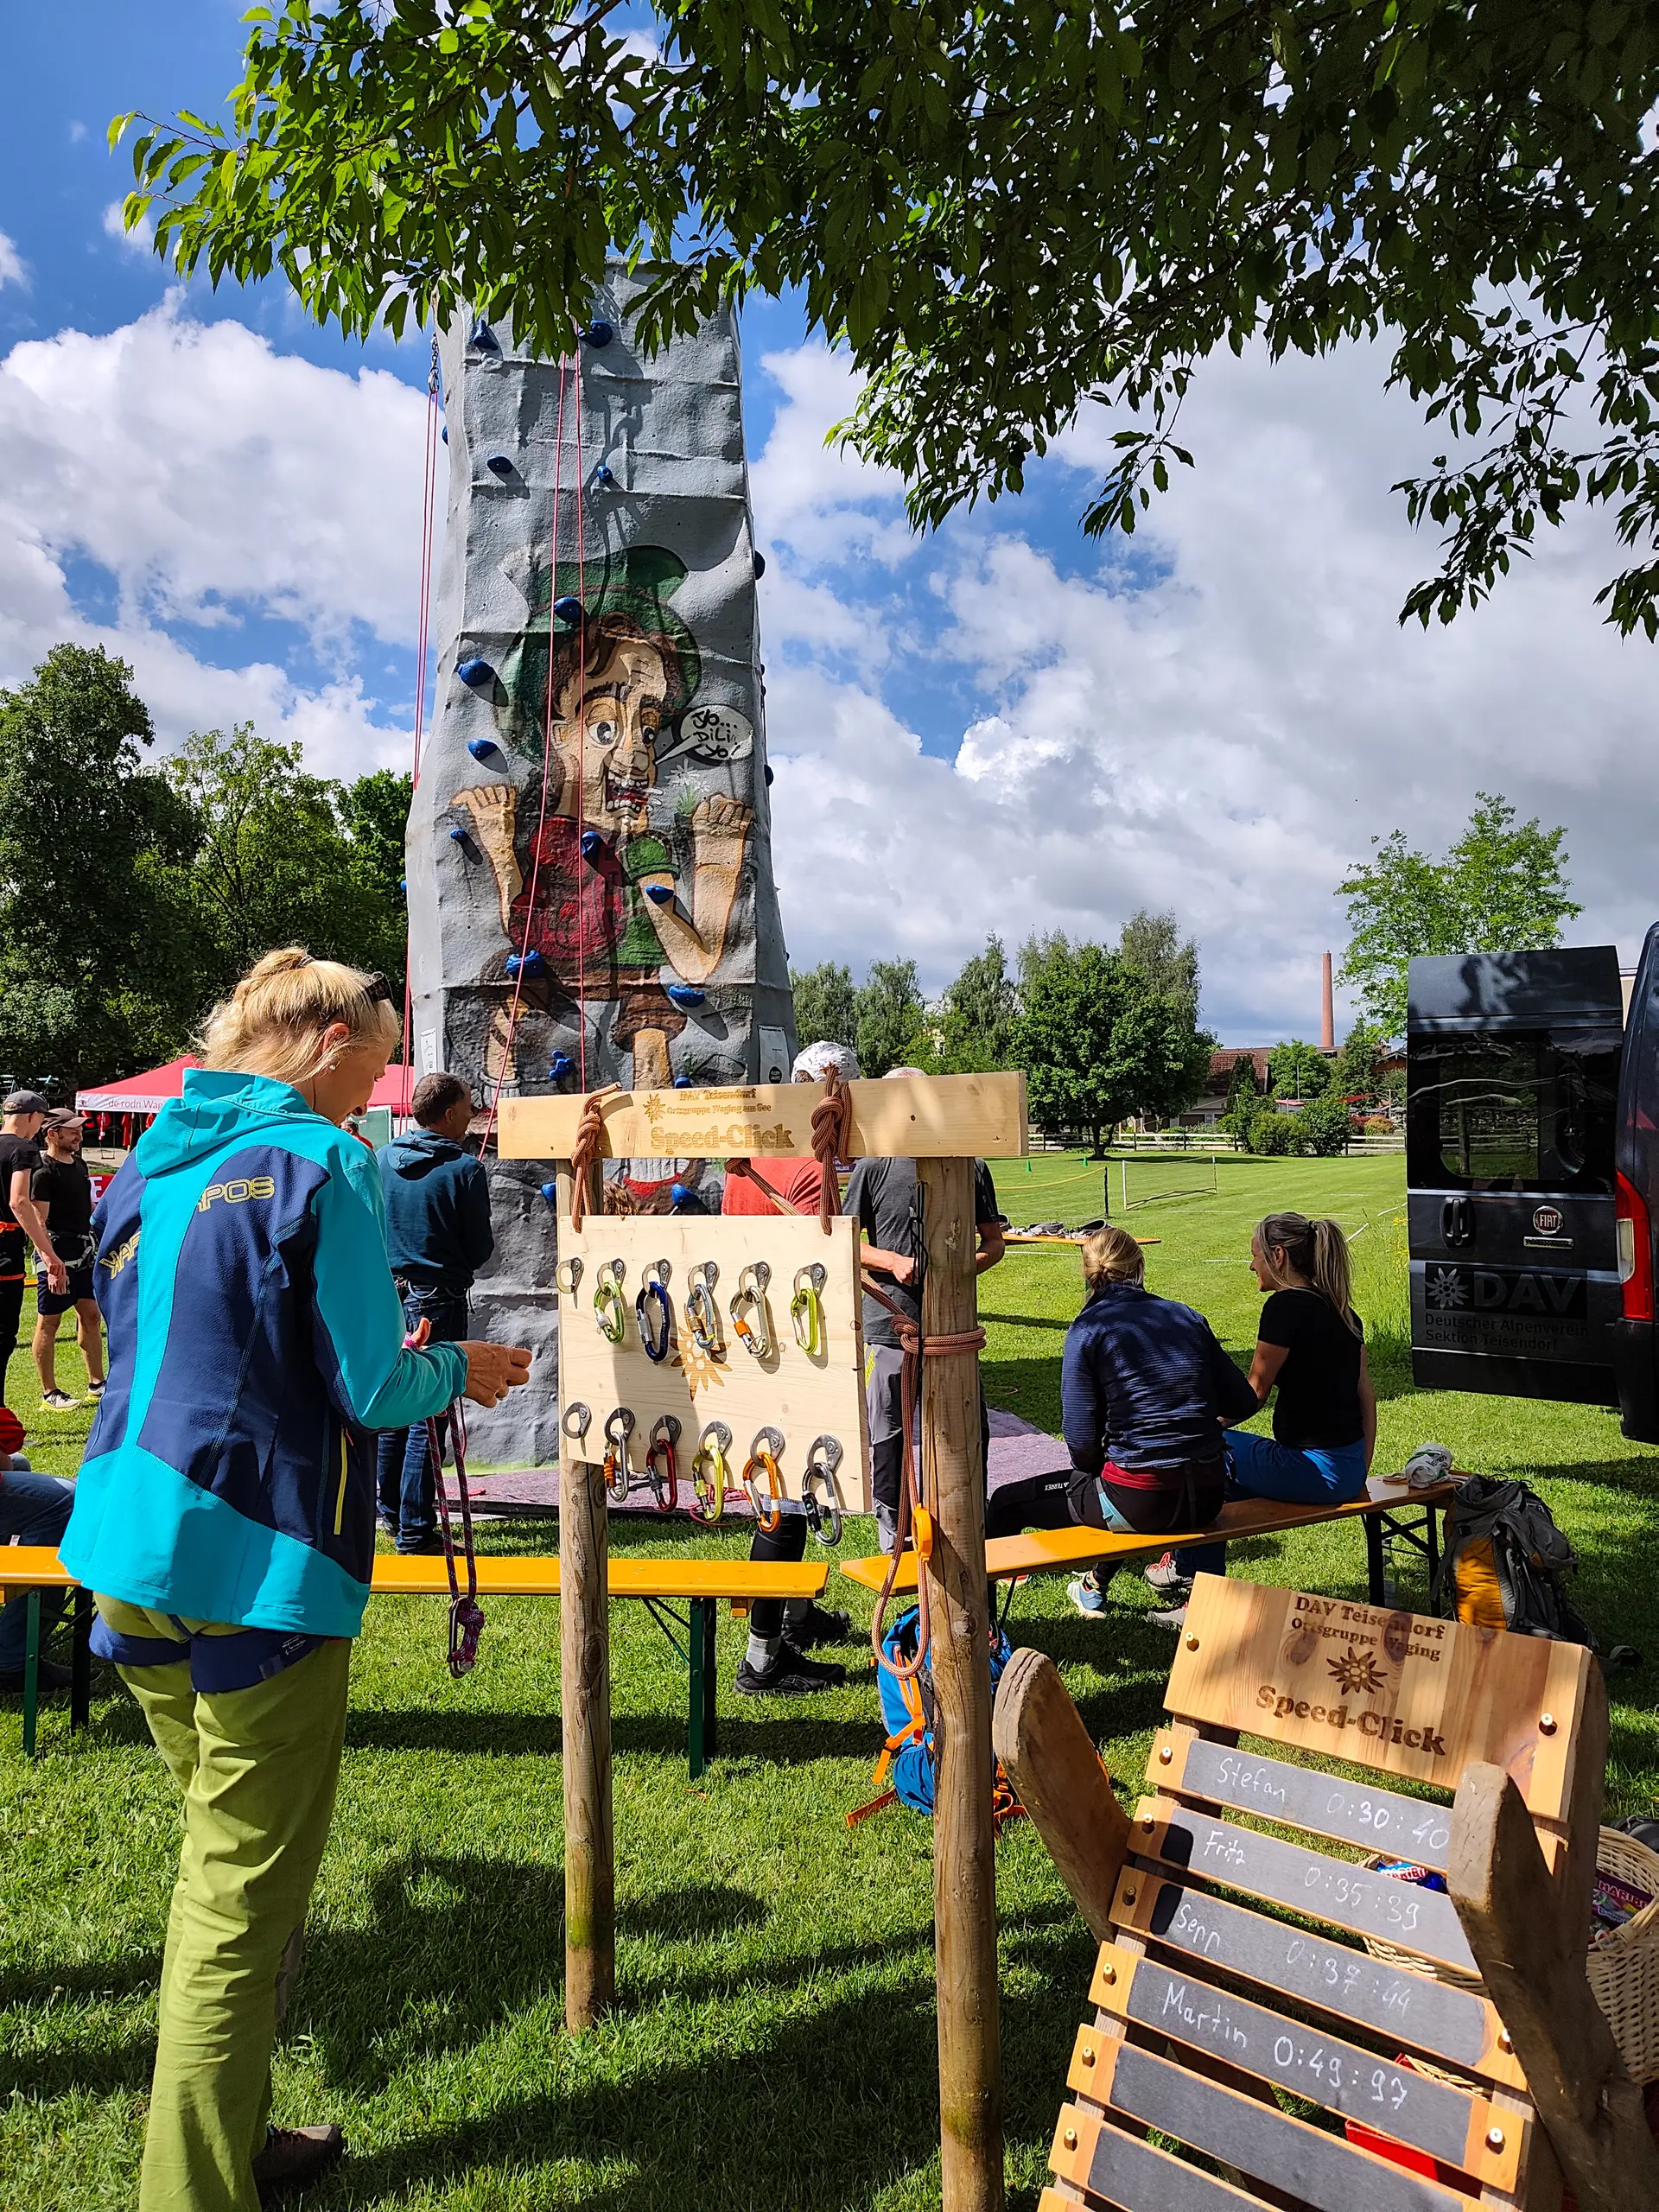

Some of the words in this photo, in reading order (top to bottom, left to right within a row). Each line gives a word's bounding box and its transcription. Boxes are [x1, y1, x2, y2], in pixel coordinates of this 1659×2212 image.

[651, 1123, 795, 1155] Speed-Click
[1539, 1214, 1558, 1228] FIAT
[1473, 1270, 1581, 1313] DAV
[1426, 1313, 1497, 1330] Deutscher
[1500, 1319, 1588, 1337] Alpenverein
[1426, 1330, 1478, 1344] Sektion
[1483, 1333, 1558, 1351] Teisendorf
[1294, 1596, 1338, 1617] DAV
[1291, 1618, 1378, 1646] Ortsgruppe
[1255, 1685, 1446, 1756] Speed-Click
[1217, 1757, 1286, 1803] Stefan
[1203, 1829, 1247, 1865] Fritz
[1162, 1981, 1249, 2049] Martin
